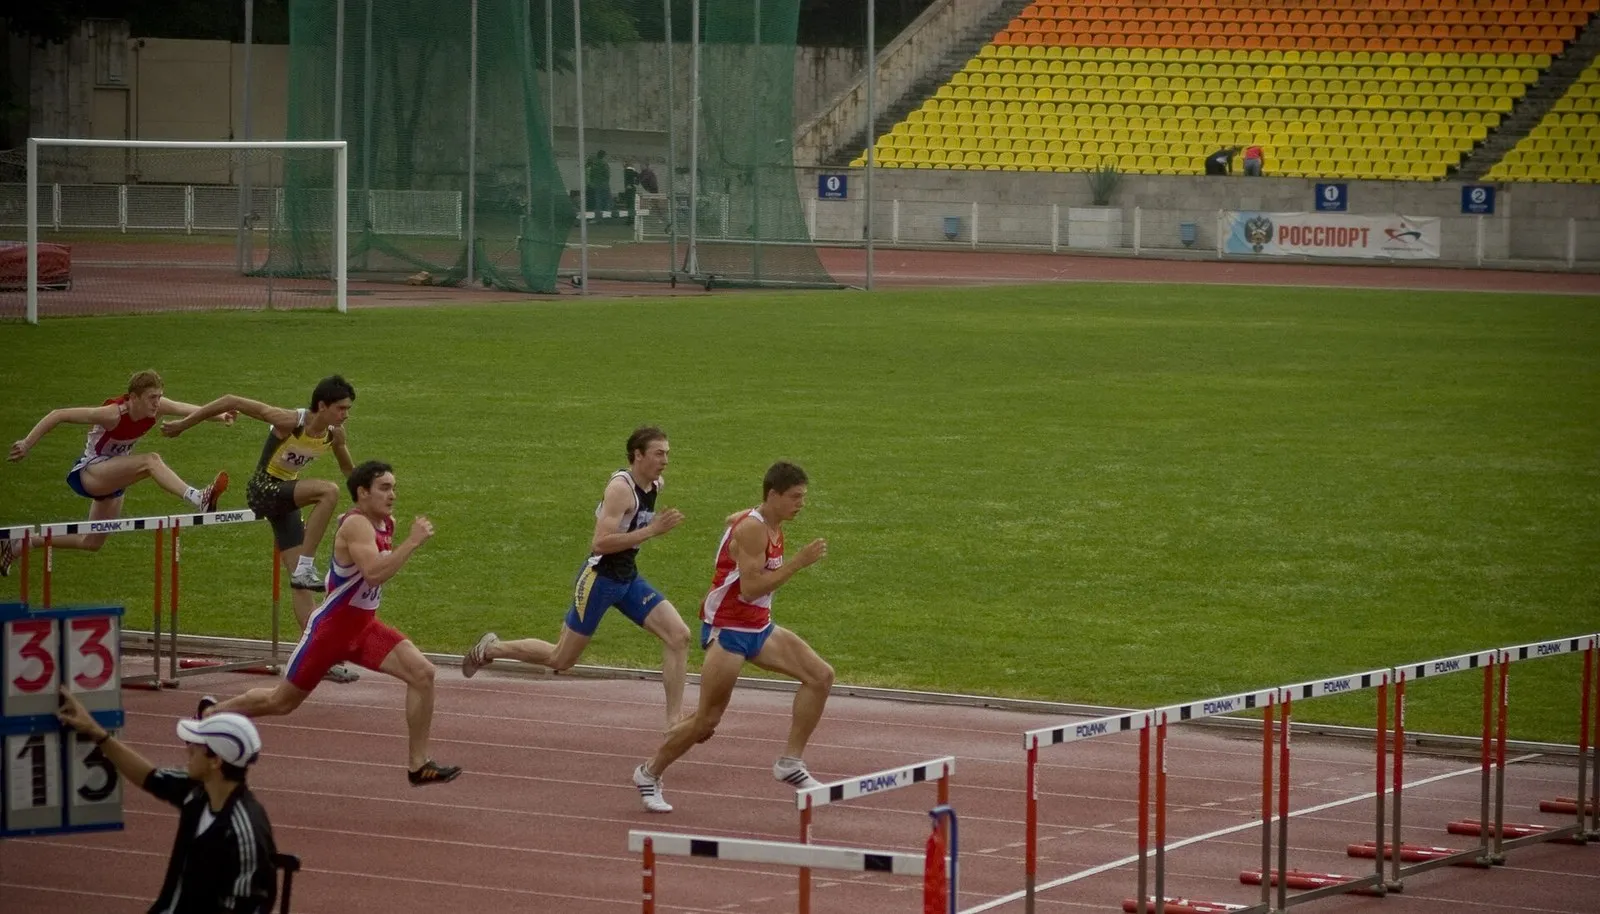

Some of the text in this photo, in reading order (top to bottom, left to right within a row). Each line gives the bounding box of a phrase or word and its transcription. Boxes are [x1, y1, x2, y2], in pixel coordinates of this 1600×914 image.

[830, 178, 836, 189] 1
[1327, 187, 1334, 199] 1
[1474, 190, 1483, 202] 2
[1278, 225, 1370, 248] РОССПОРТ
[215, 512, 244, 523] POLANIK
[90, 521, 122, 532] POLANIK
[1537, 643, 1562, 655] POLANIK
[1434, 659, 1460, 673] POLANIK
[1323, 679, 1351, 693] POLANIK
[1203, 700, 1234, 715] POLANIK
[1076, 722, 1108, 738] POLANIK
[859, 774, 898, 794] POLANIK
